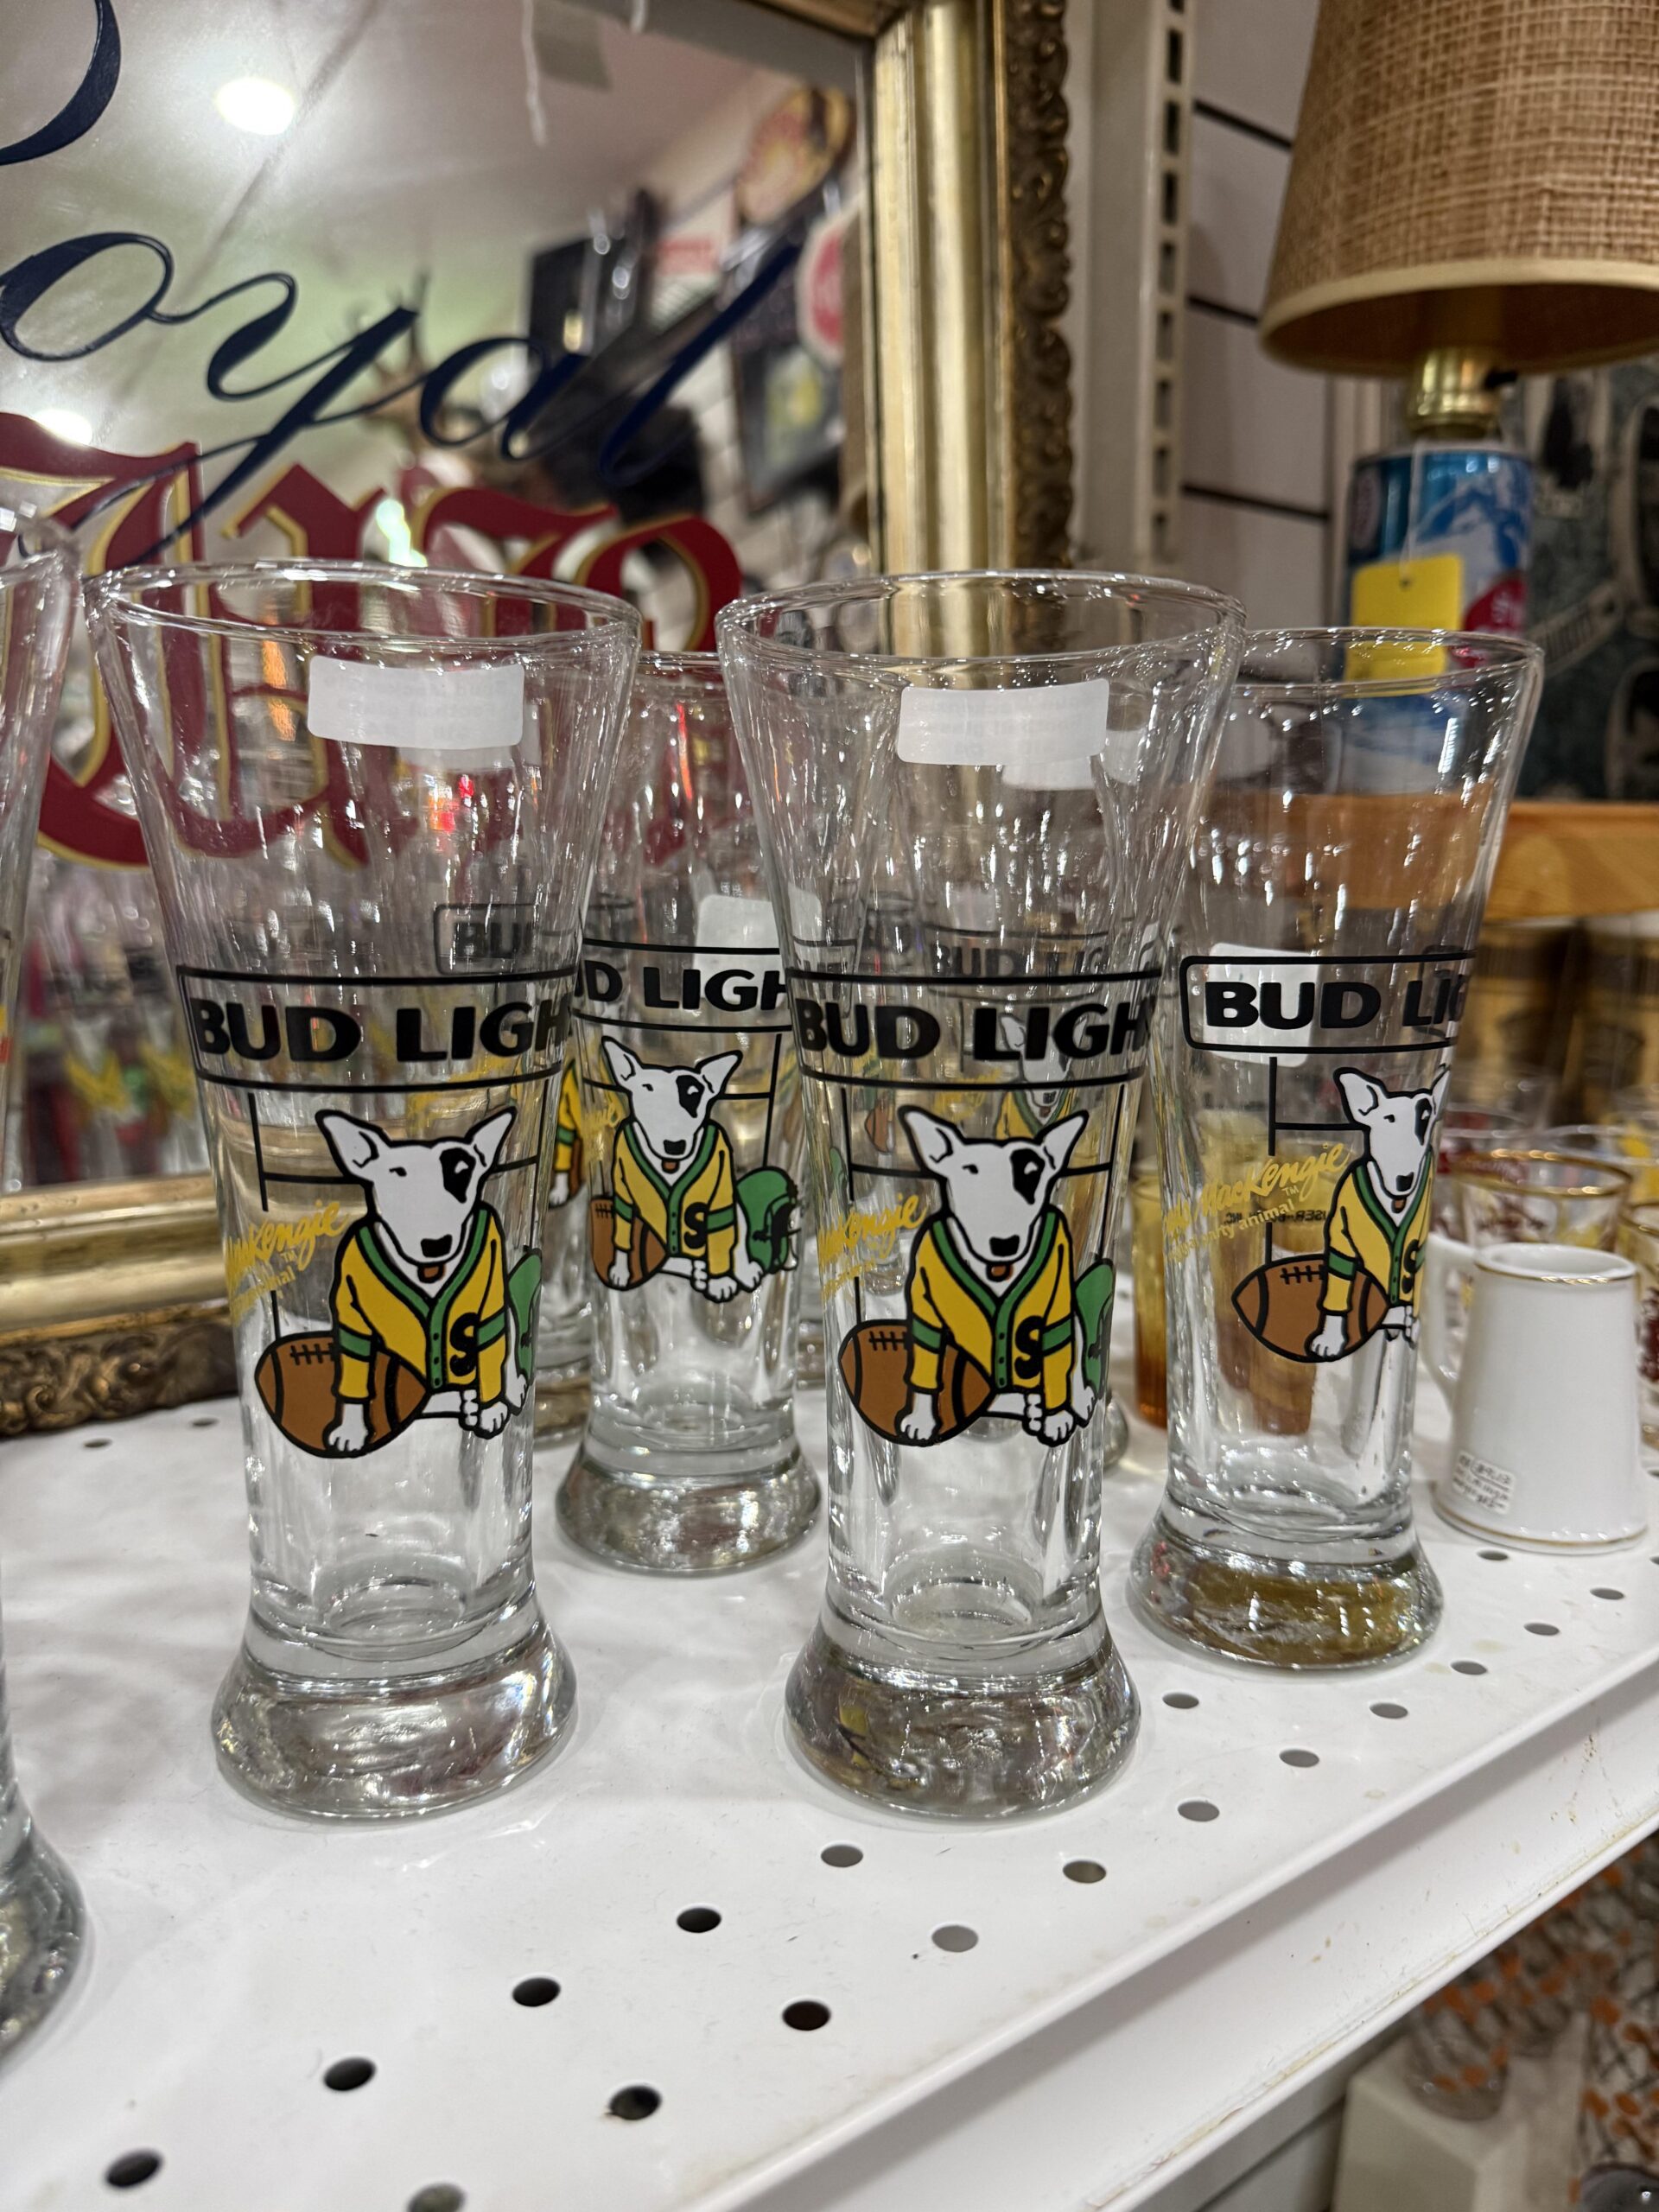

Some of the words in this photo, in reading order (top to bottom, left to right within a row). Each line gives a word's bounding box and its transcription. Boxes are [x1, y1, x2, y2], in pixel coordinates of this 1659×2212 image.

[454, 921, 534, 961] BU
[644, 967, 787, 1012] LIGH
[1205, 982, 1382, 1030] BUD
[189, 998, 362, 1062] BUD
[396, 995, 571, 1062] LIGH
[795, 999, 941, 1060] BUD
[974, 996, 1151, 1061] LIGH
[1239, 1198, 1295, 1230] animal
[449, 1312, 477, 1378] S
[1014, 1315, 1043, 1380] S
